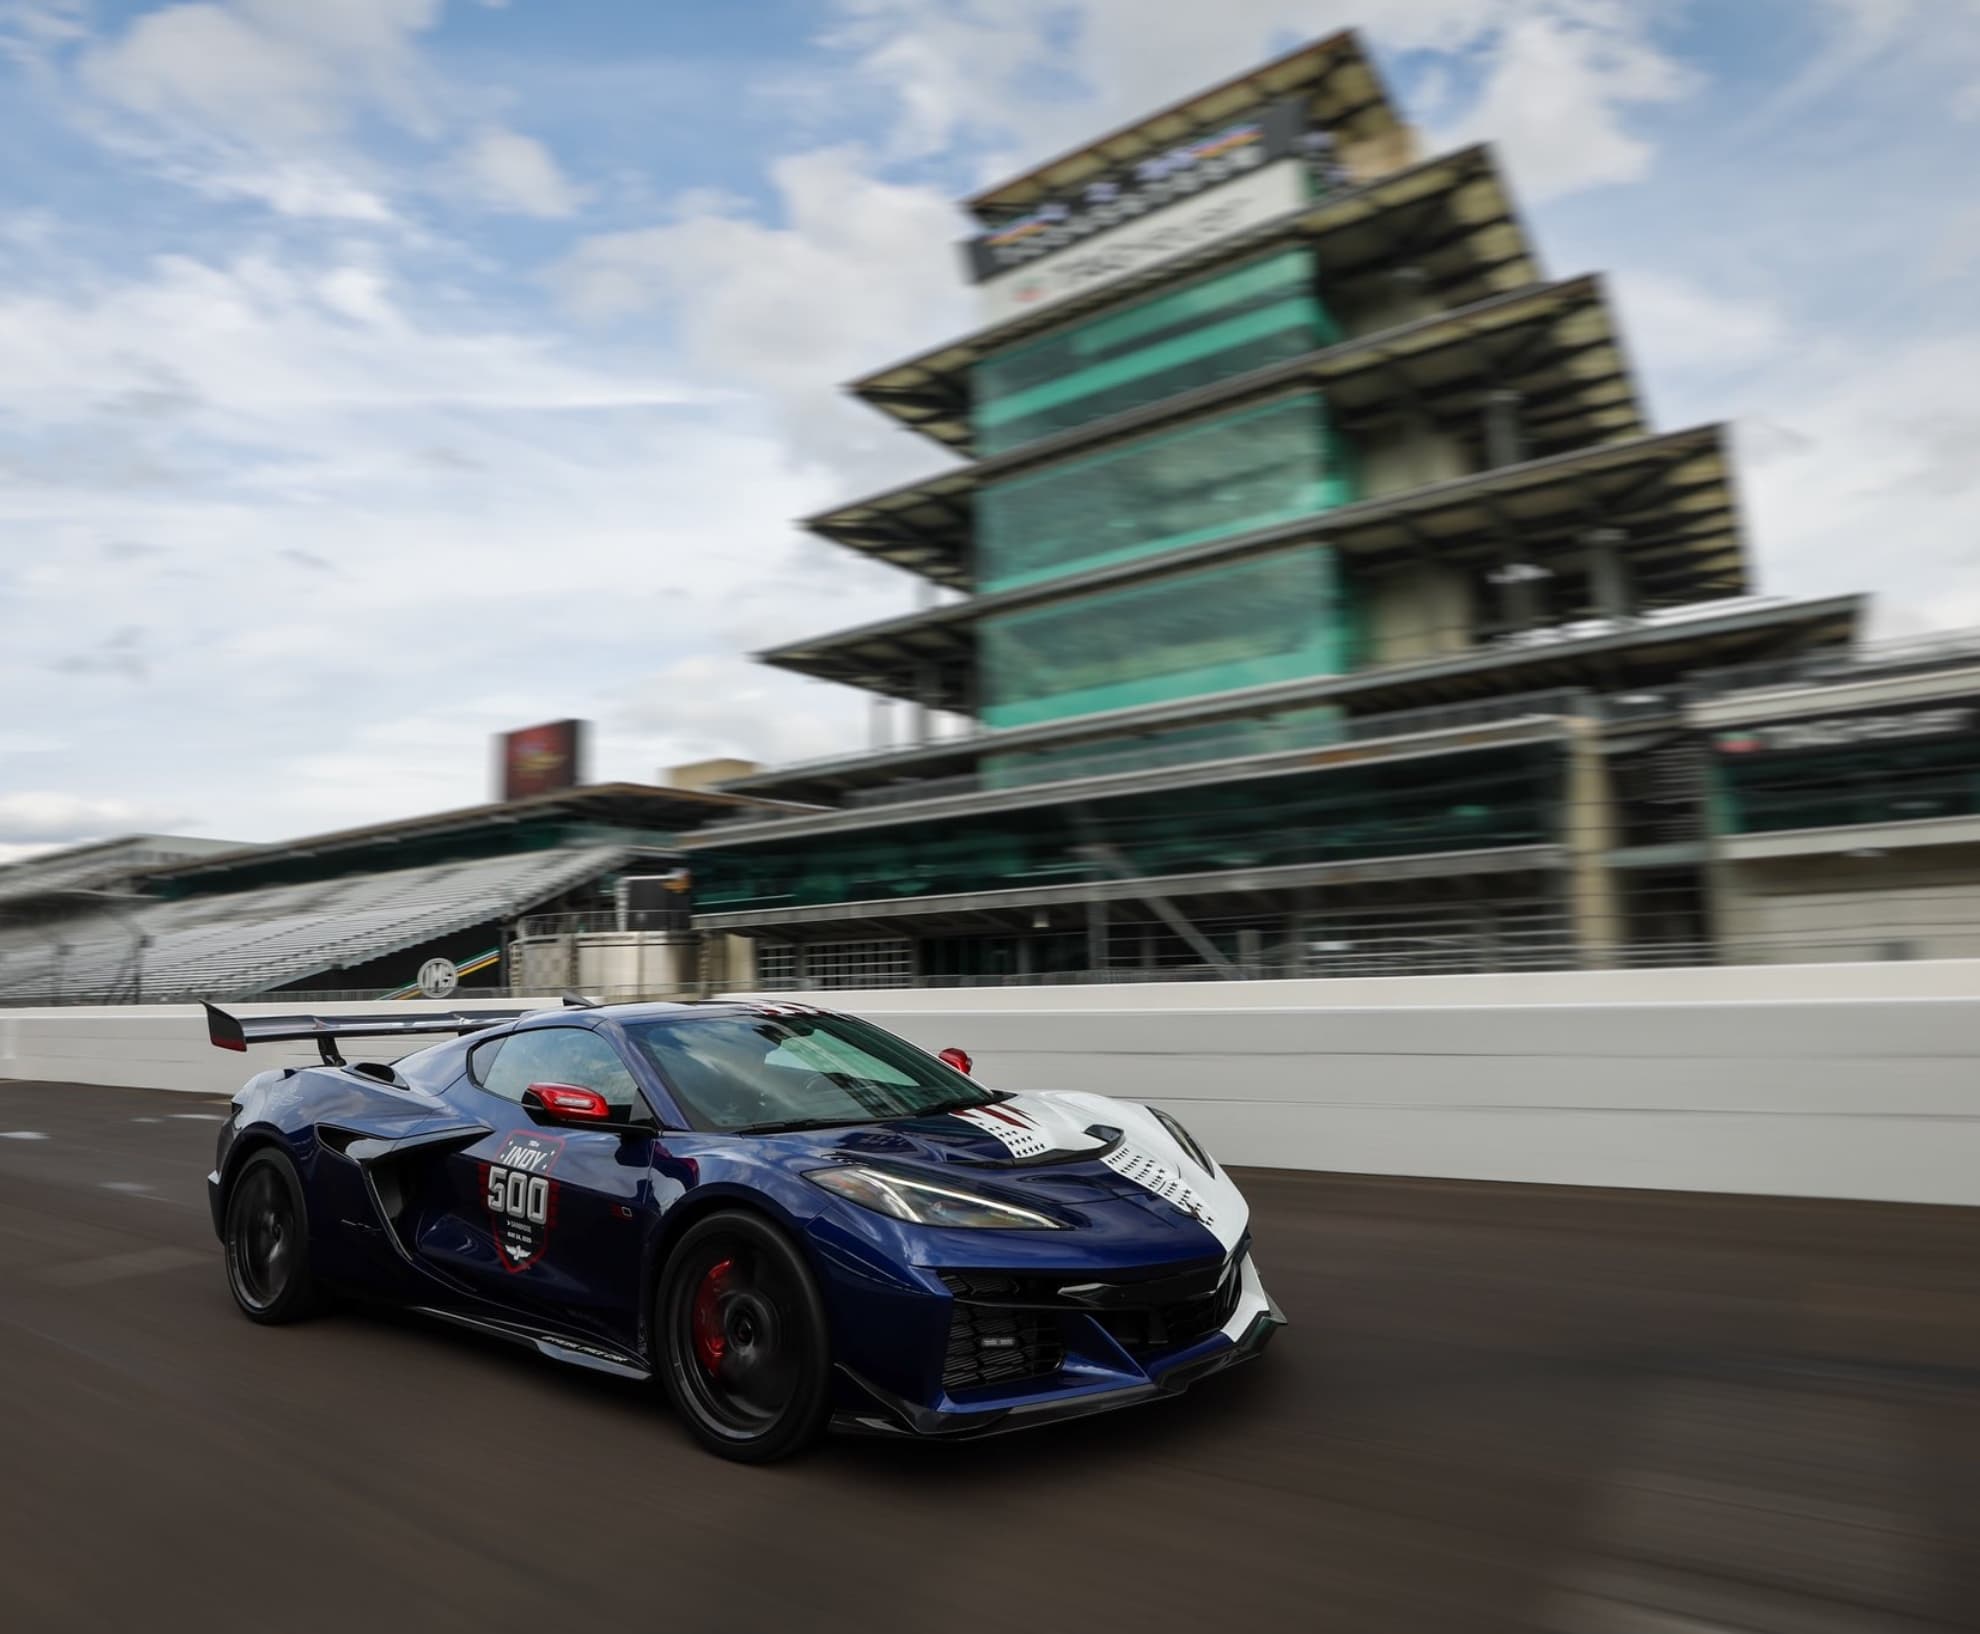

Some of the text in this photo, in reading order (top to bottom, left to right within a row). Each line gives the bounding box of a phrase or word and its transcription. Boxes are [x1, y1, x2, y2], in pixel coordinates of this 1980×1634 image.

[422, 962, 455, 994] IMS
[502, 1145, 548, 1171] INDY
[488, 1165, 549, 1225] 500
